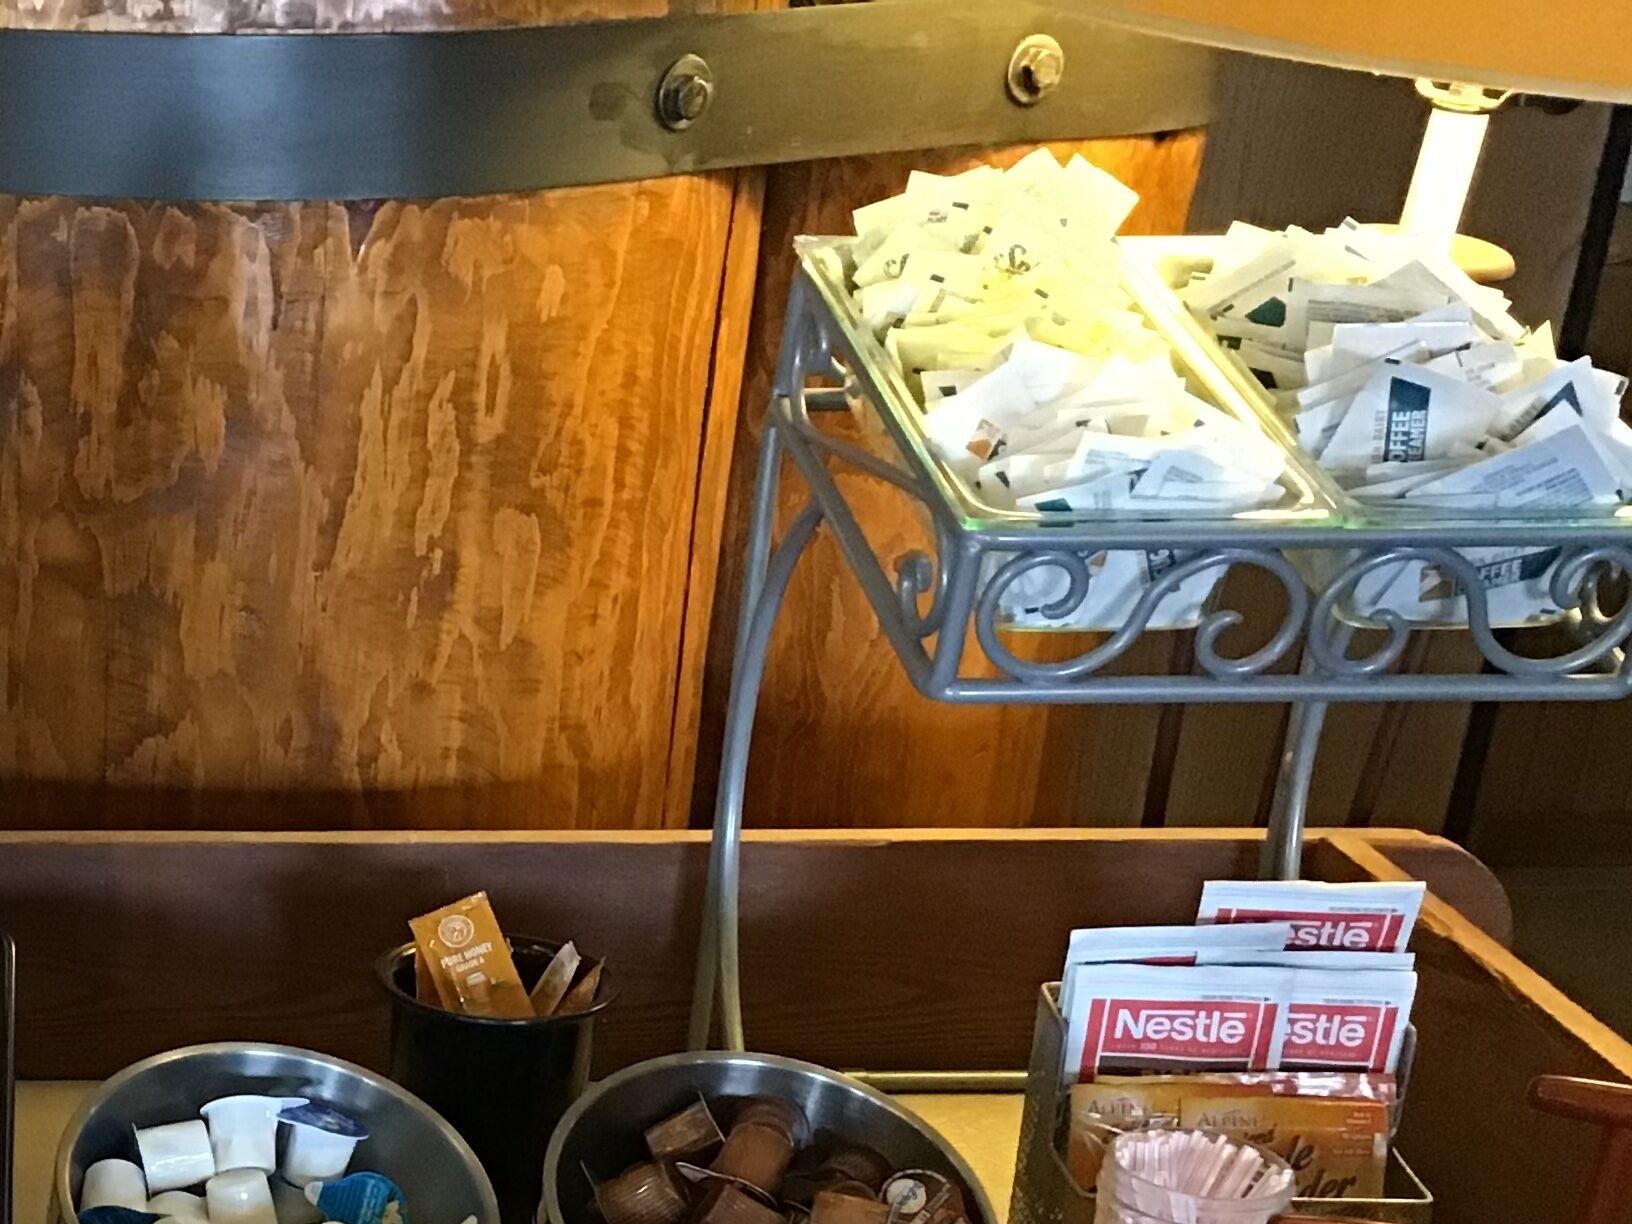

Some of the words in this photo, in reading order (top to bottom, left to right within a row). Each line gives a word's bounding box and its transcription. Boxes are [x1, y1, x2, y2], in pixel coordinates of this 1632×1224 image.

[1388, 411, 1410, 460] OFFEE
[1408, 410, 1428, 460] EAMER
[1285, 1013, 1366, 1047] stlé
